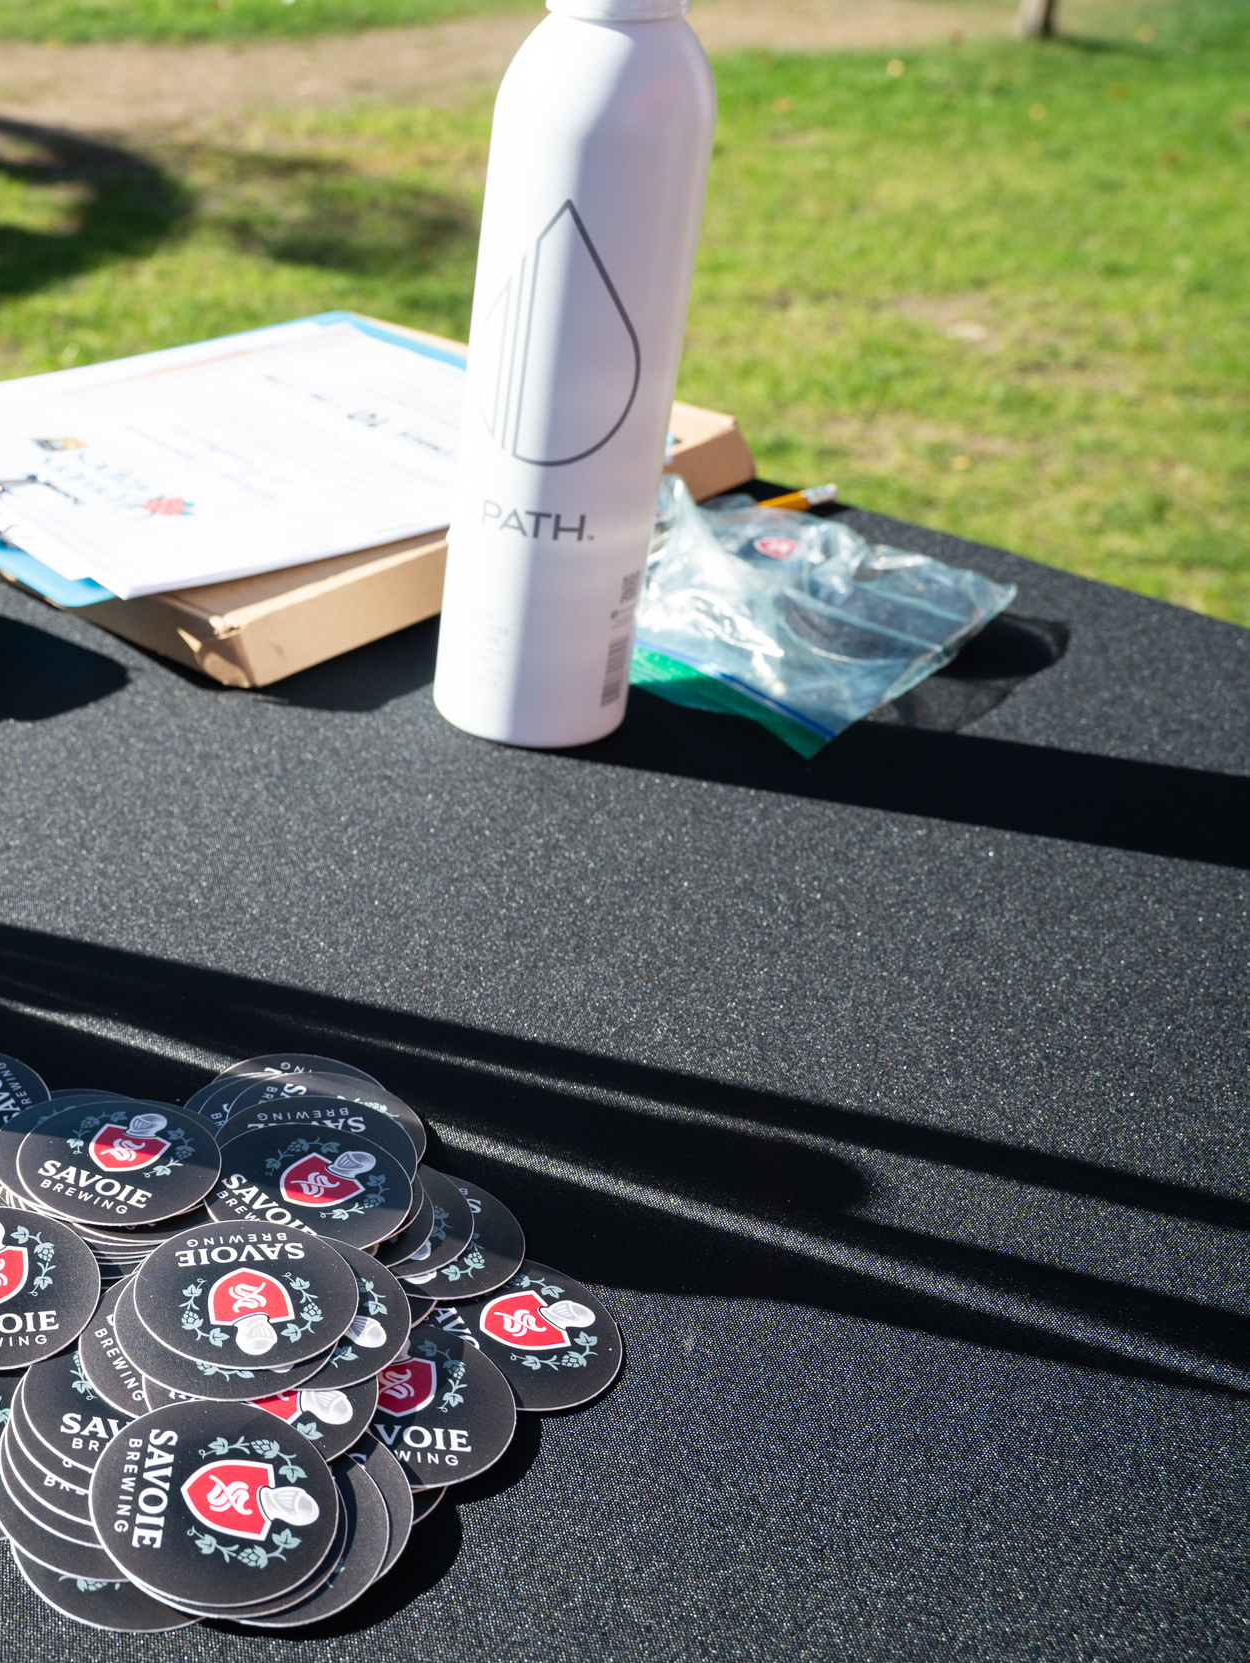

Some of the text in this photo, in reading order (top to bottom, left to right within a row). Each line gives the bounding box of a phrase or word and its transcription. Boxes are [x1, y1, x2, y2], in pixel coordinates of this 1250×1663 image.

[256, 1107, 349, 1120] BREWING
[37, 1160, 153, 1209] SAVOIE
[40, 1179, 128, 1214] BREWING
[216, 1190, 260, 1221] BREW
[175, 1243, 305, 1267] SAVOIE
[187, 1233, 287, 1247] BREWING
[95, 1328, 144, 1401] BREWING
[374, 1425, 472, 1452] VOIE
[394, 1449, 459, 1467] WING
[114, 1438, 143, 1532] BREWING
[132, 1429, 178, 1548] SAVOIE
